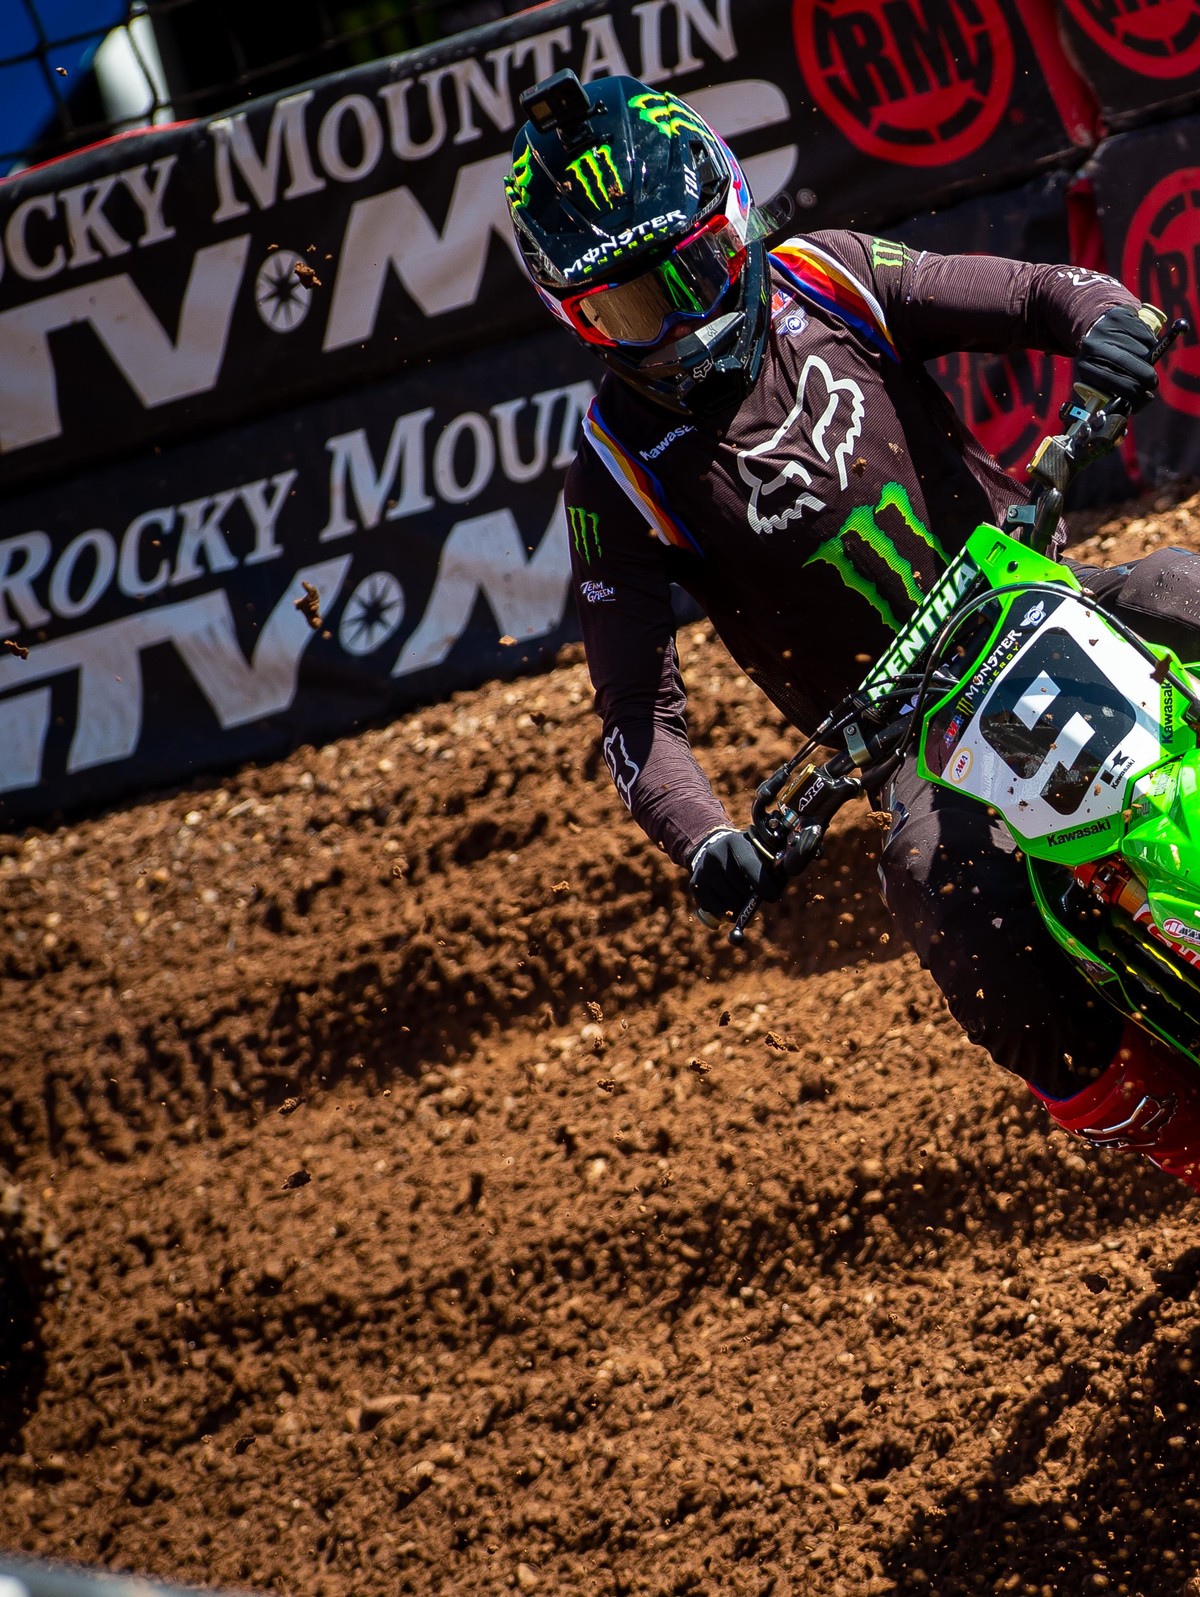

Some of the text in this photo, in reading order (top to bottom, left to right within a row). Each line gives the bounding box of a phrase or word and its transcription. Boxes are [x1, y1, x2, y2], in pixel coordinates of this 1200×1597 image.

[580, 580, 604, 595] TEAM
[587, 586, 615, 603] GREEN
[1160, 679, 1174, 745] Kawasak
[1110, 757, 1136, 791] Kawasaki
[1046, 818, 1112, 848] Kawasaki
